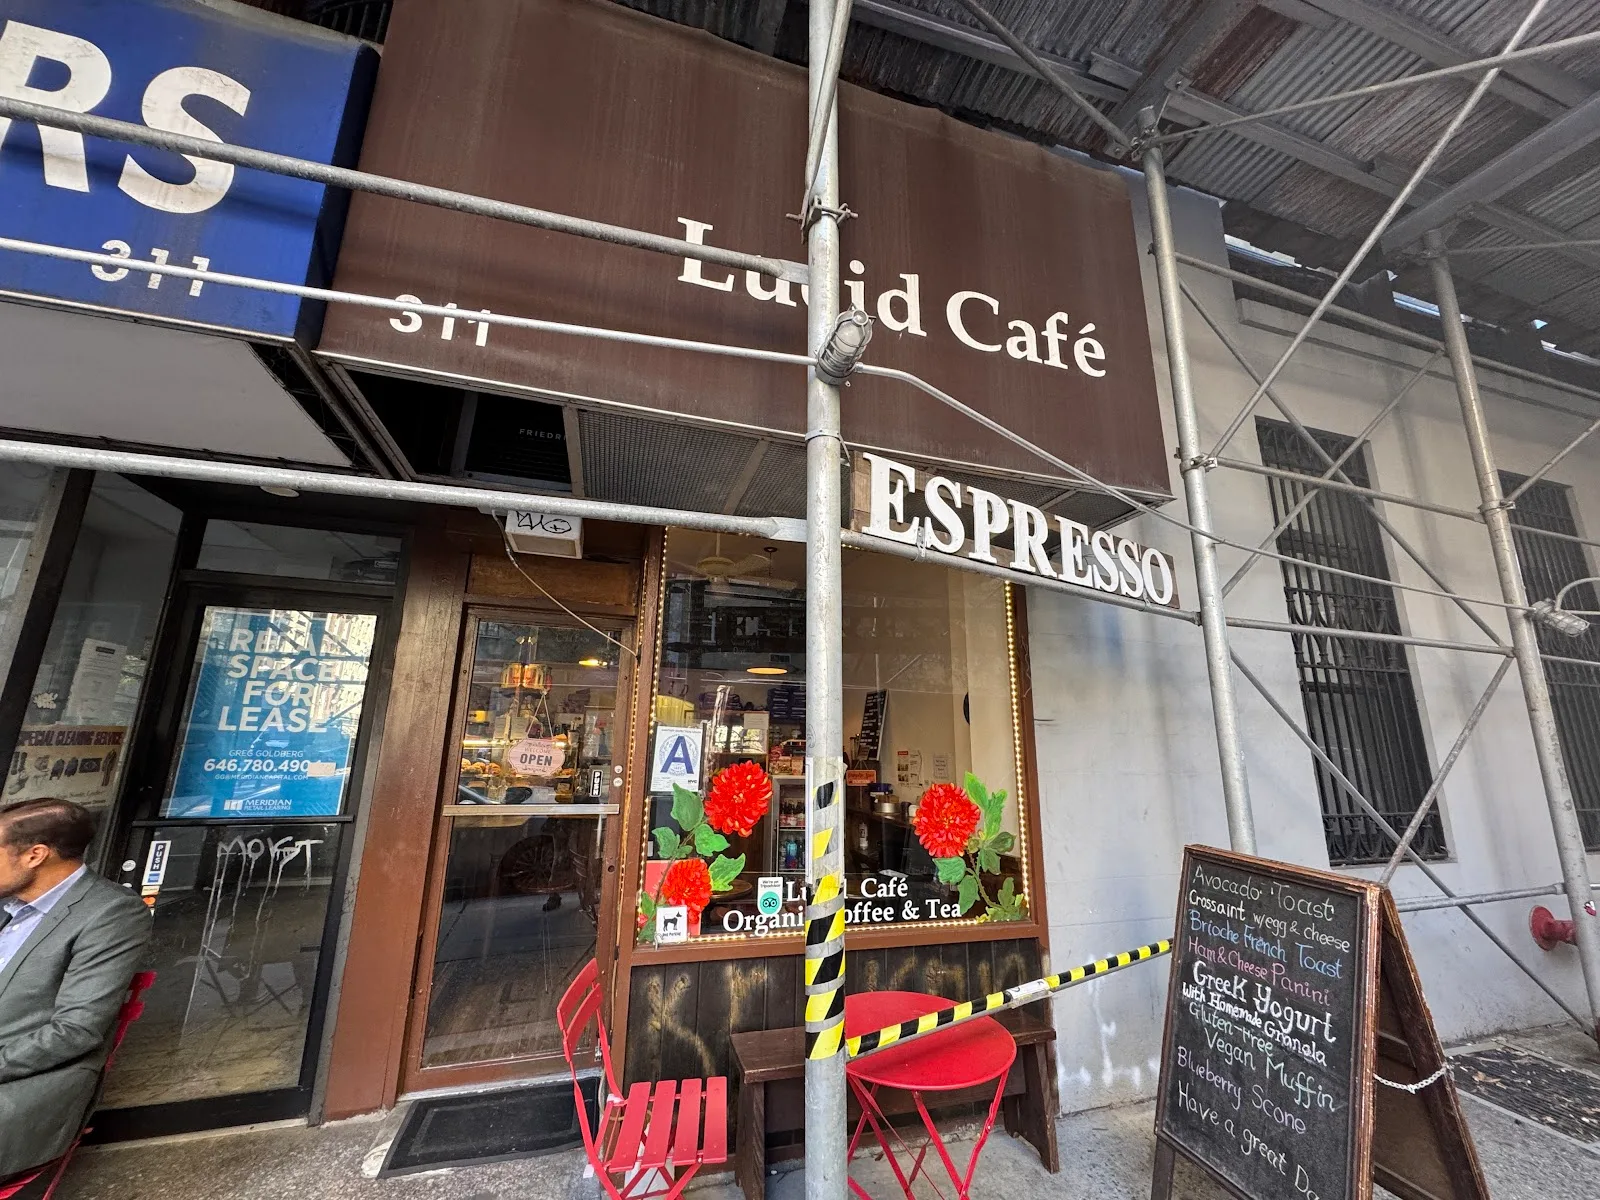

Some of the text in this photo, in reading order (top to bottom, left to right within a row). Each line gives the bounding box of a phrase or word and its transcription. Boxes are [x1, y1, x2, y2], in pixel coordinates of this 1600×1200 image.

[90, 239, 210, 297] 311
[676, 216, 1107, 377] Luid Café
[389, 294, 491, 347] 311
[861, 451, 1173, 606] ESPRESSO
[227, 654, 340, 682] SPACE
[242, 680, 316, 707] FOR
[218, 706, 329, 733] LEASE
[204, 758, 321, 772] 646.780.490
[229, 749, 304, 758] GREG GOLDBERG
[520, 754, 552, 767] OPEN
[660, 736, 694, 774] A
[152, 844, 164, 870] PUSH
[860, 877, 908, 898] Café
[1193, 864, 1334, 921] Avocado Toast
[723, 898, 962, 937] Organi offee & Tea
[1289, 920, 1300, 936] &
[1303, 923, 1351, 953] cheese
[1189, 909, 1343, 979] Brioche French Toast
[1271, 962, 1330, 1006] Panini
[1208, 991, 1262, 1028] Homemade
[1264, 1021, 1327, 1067] Granola
[1177, 1046, 1306, 1134] Blueberry Scone
[1204, 1027, 1335, 1112] Vegan Muffin
[1178, 1080, 1219, 1126] Have
[1224, 1119, 1236, 1138] a
[1241, 1128, 1287, 1175] great
